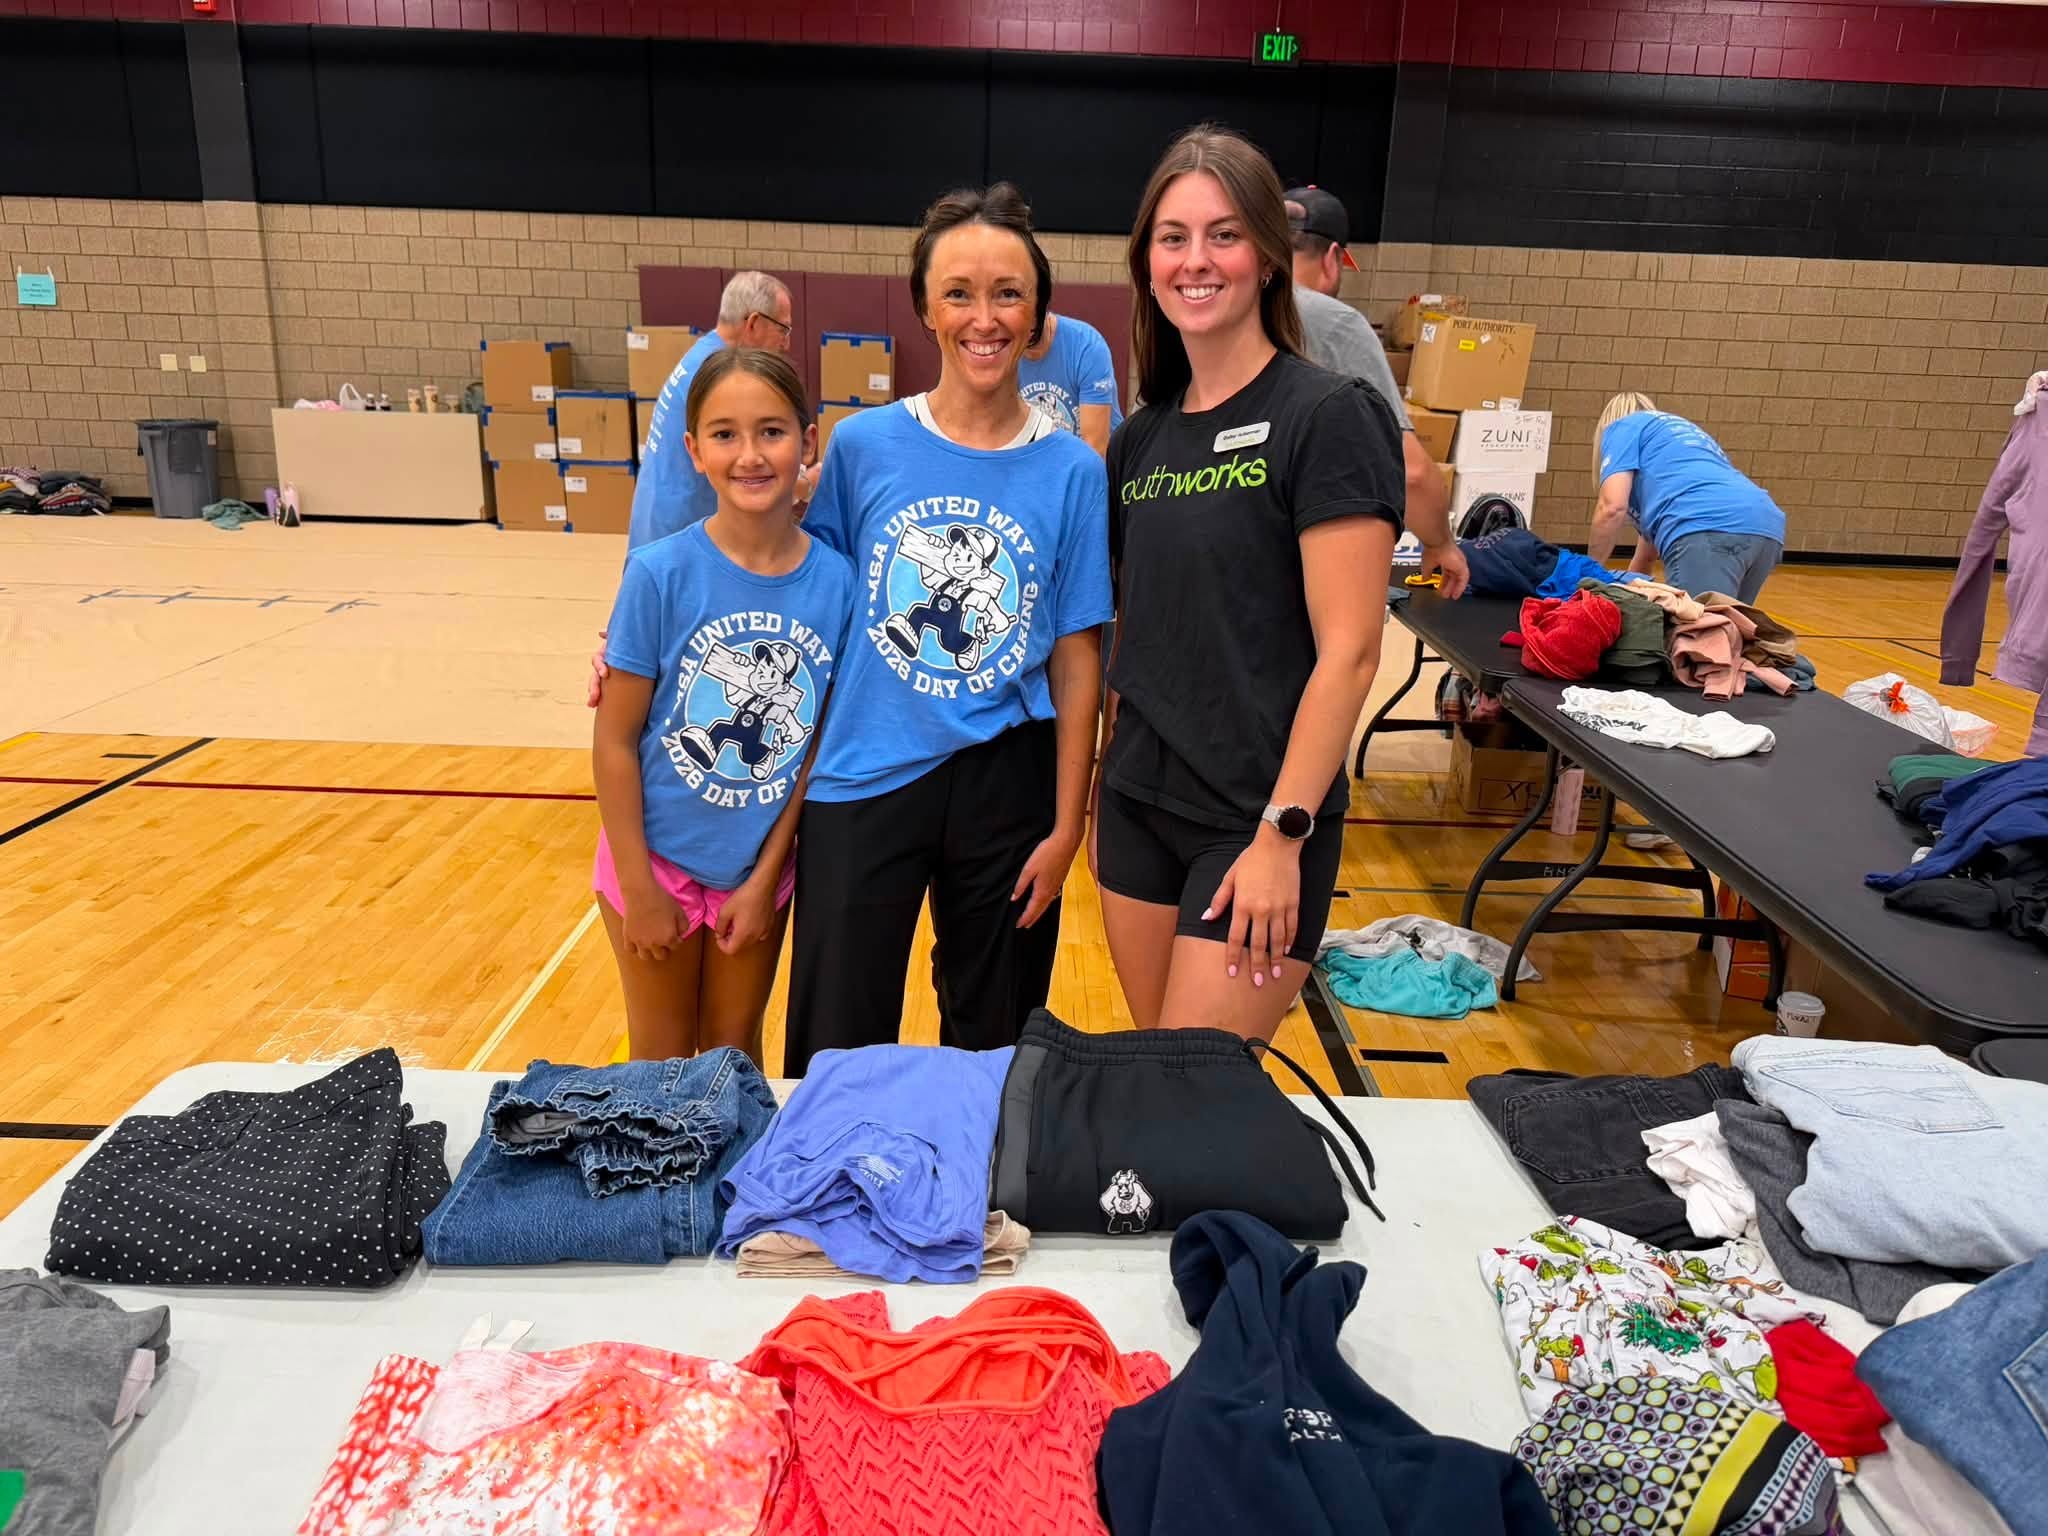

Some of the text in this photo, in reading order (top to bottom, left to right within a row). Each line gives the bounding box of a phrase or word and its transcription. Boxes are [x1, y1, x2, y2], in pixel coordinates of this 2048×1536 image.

[1263, 34, 1295, 61] EXIT
[1452, 319, 1473, 331] PORT
[1020, 382, 1070, 401] ITED WAY
[1481, 429, 1531, 443] ZUNI
[1121, 454, 1268, 505] outhworks
[867, 496, 1036, 603] MSA UNITED WAY
[689, 611, 782, 654] UNITED
[789, 618, 832, 666] WAY
[866, 621, 912, 682] 2026
[913, 670, 960, 699] DAY
[966, 667, 996, 694] OF
[660, 731, 788, 808] 2026 DAY OF
[1290, 1428, 1343, 1443] ALTH
